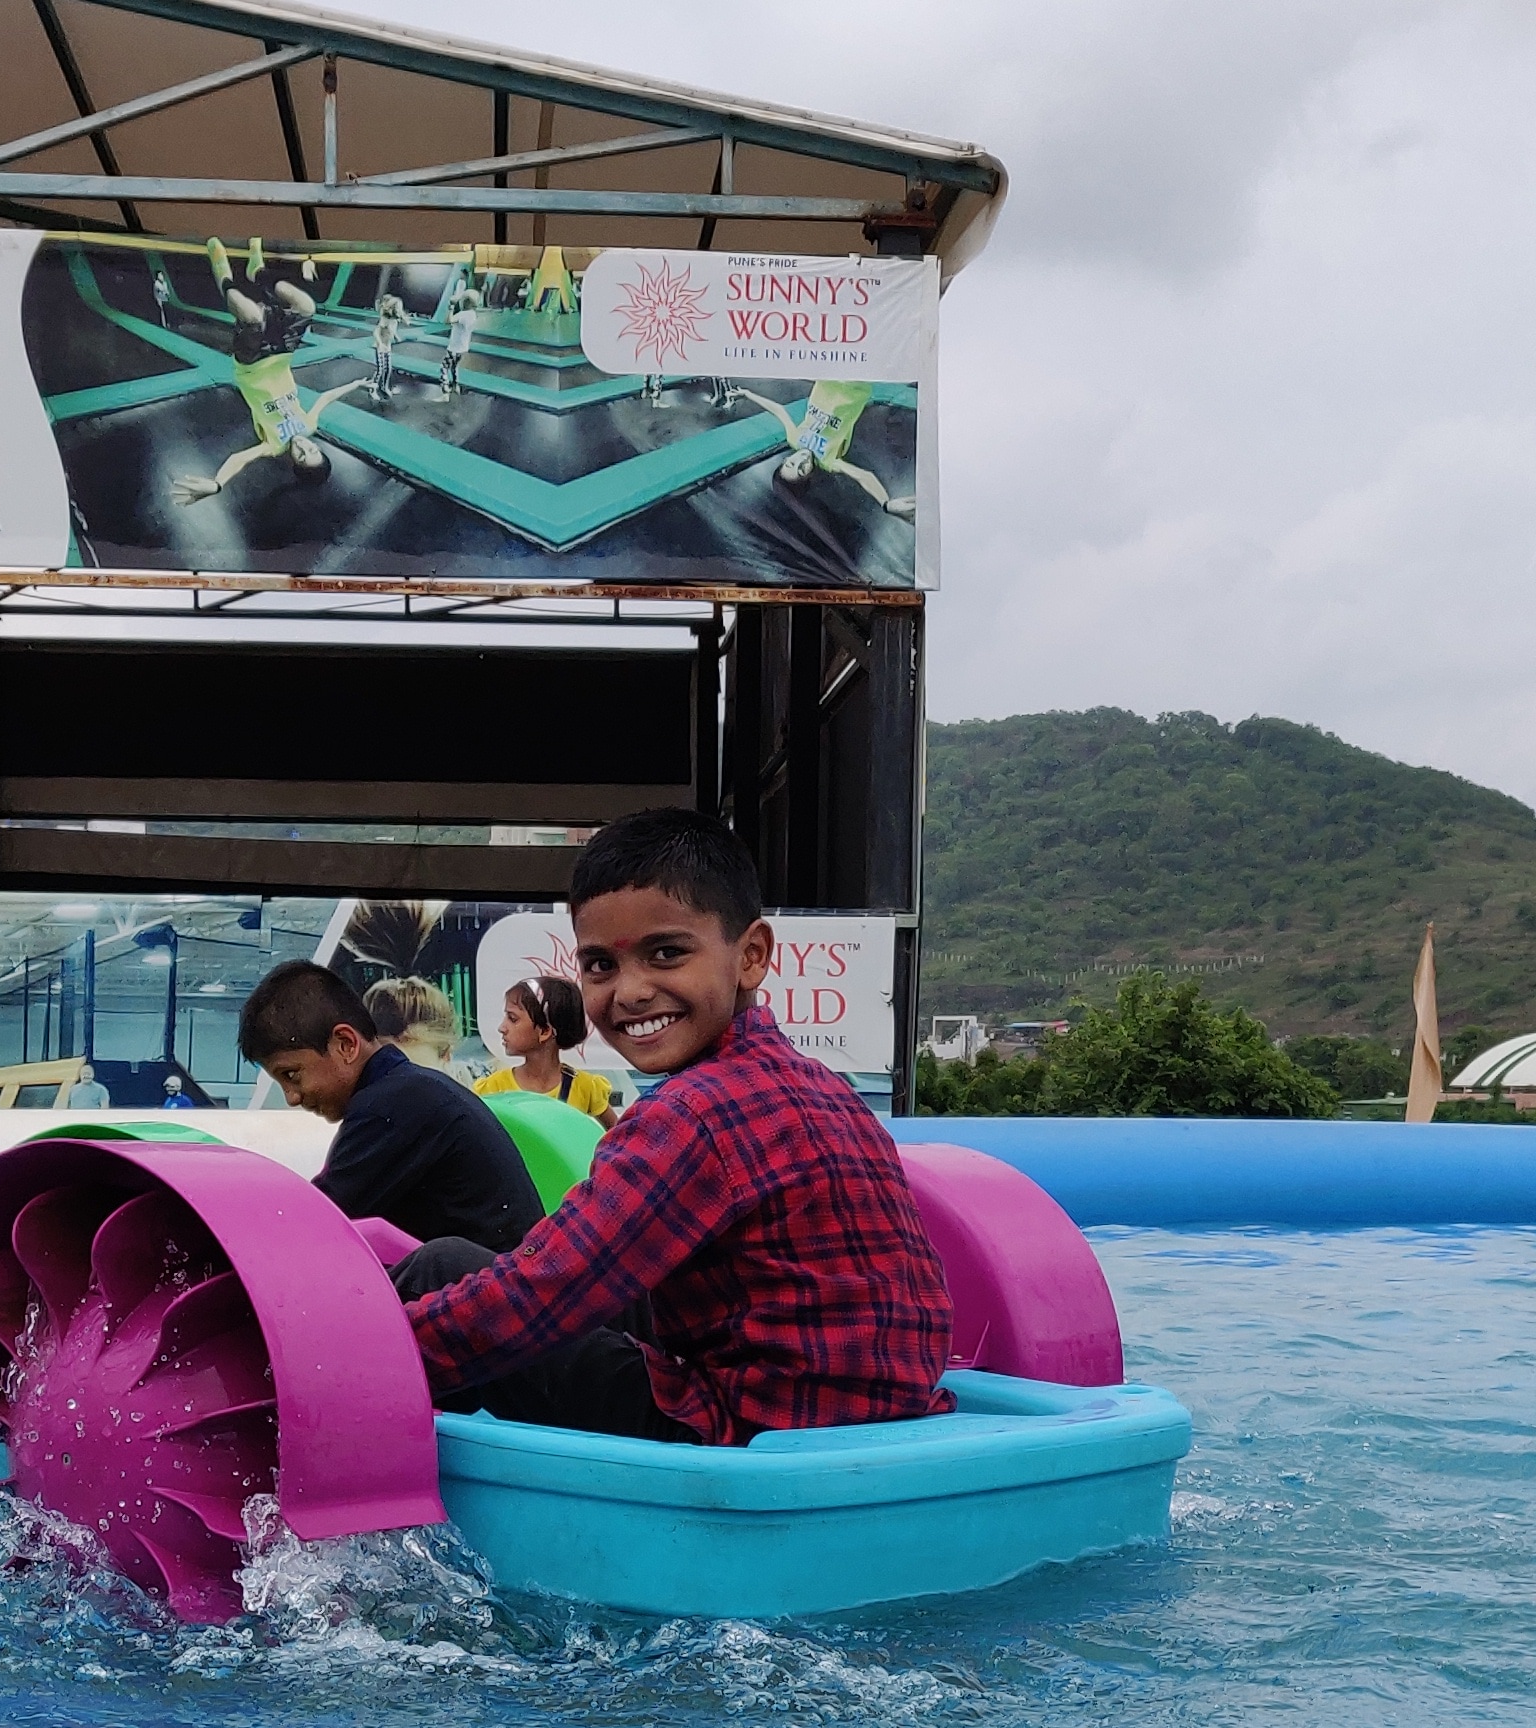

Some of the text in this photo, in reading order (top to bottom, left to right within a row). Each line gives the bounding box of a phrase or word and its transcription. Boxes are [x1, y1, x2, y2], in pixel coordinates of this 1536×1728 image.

[727, 256, 799, 268] PUNE'S PRIDE
[726, 309, 868, 343] WORLD
[724, 347, 868, 362] LIFE IN FUNSHINE
[768, 942, 847, 978] NY'S
[756, 988, 847, 1025] RLD
[788, 1035, 848, 1047] SHINE
